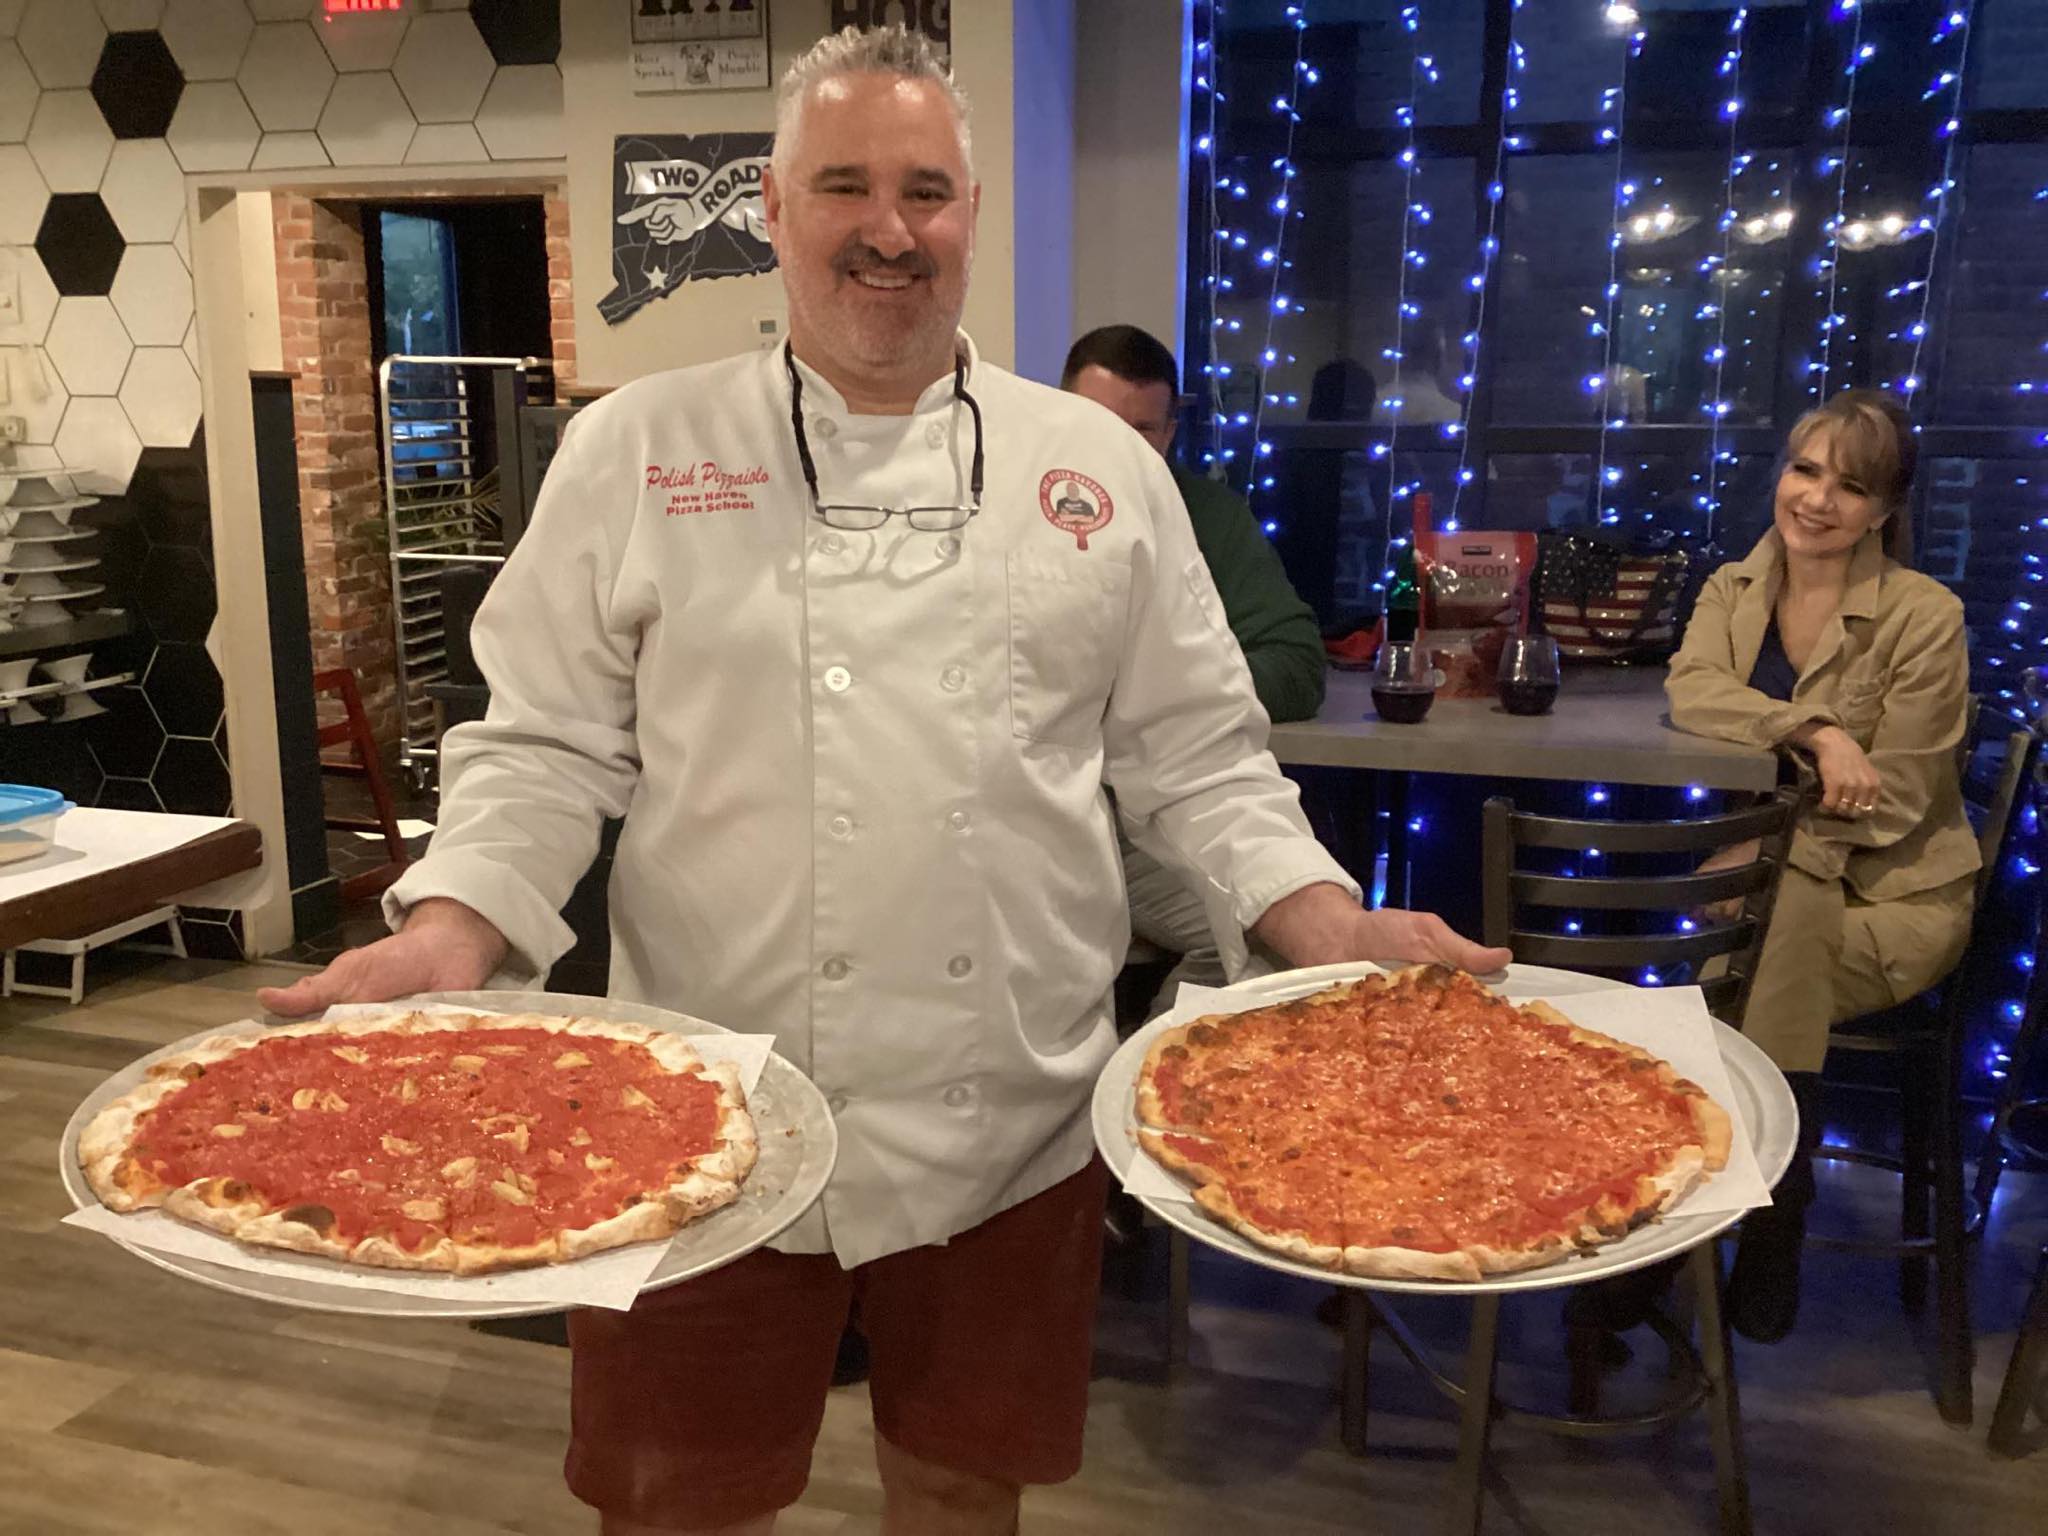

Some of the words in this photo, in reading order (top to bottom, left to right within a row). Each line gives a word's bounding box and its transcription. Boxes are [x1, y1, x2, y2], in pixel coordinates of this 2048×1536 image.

[650, 166, 700, 188] TWO
[700, 162, 770, 215] ROAD
[646, 462, 695, 491] Polish
[701, 461, 769, 490] Pizzaiolo
[666, 504, 703, 516] Pizza
[706, 500, 755, 513] School
[672, 494, 701, 505] New
[704, 490, 748, 502] Haven
